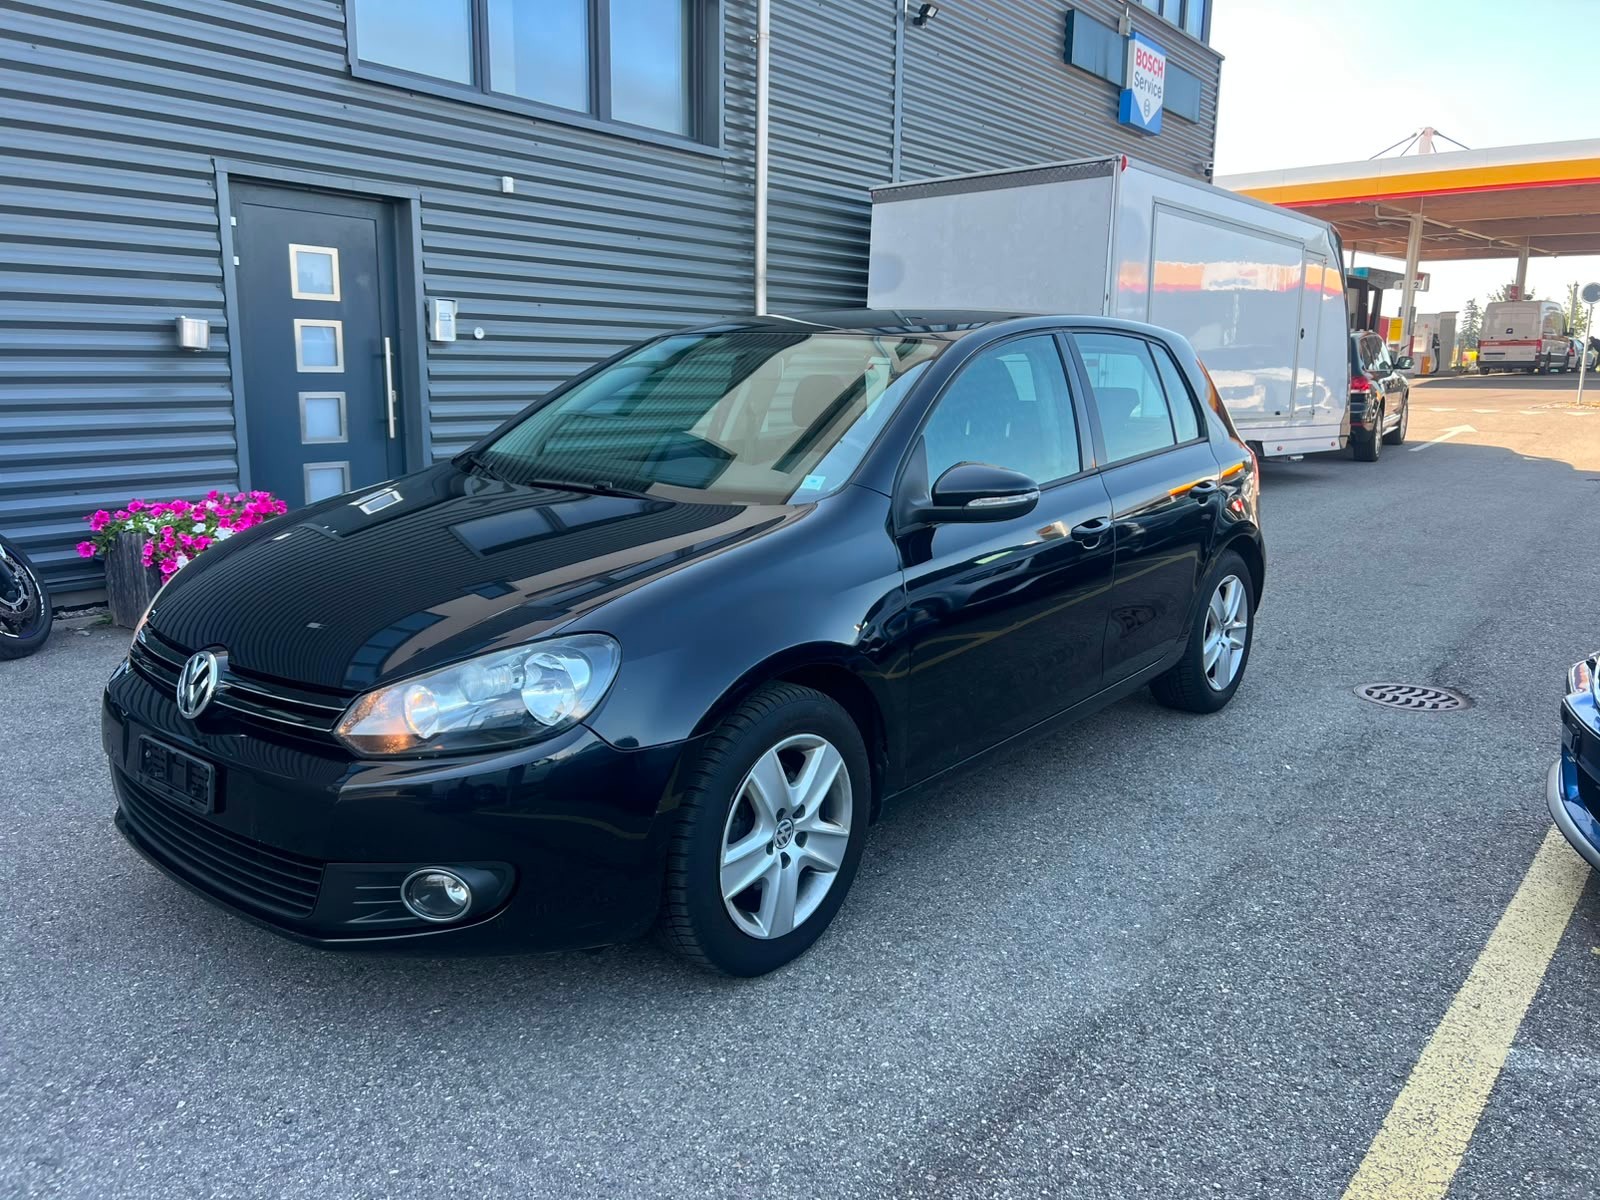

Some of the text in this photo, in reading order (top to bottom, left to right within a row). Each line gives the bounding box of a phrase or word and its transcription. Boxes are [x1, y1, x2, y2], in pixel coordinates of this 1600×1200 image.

[1135, 47, 1164, 78] BOSCH
[1134, 71, 1162, 99] Service
[1413, 281, 1419, 289] 2
